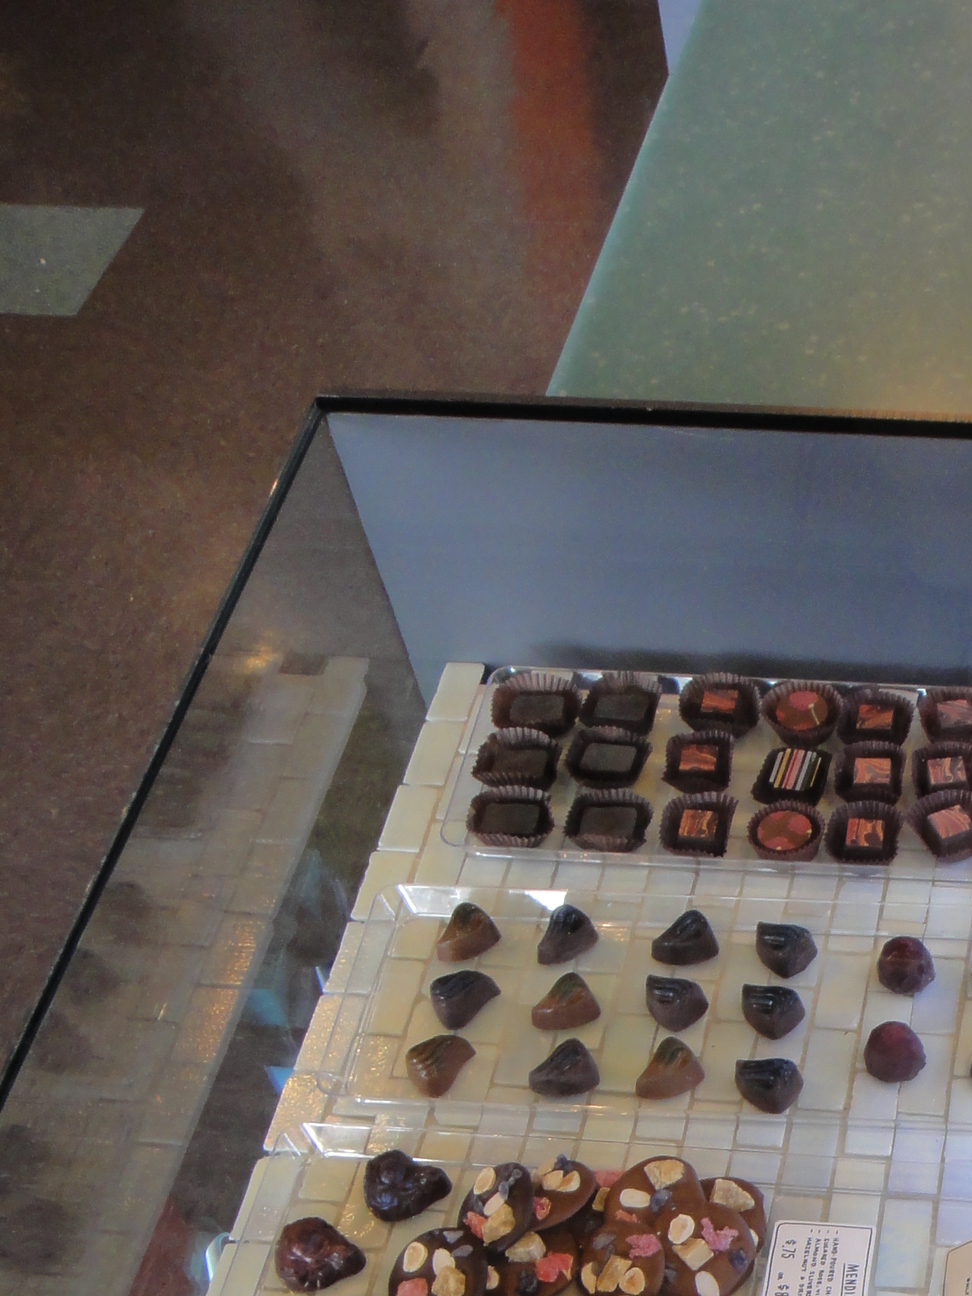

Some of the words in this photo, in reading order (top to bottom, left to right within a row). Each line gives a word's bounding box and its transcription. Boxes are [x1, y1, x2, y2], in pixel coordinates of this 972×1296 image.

[801, 1236, 811, 1272] HAZELNUT
[810, 1238, 820, 1267] ALMOND
[819, 1238, 829, 1265] SUGARED
[827, 1237, 838, 1282] HAND-POURED
[777, 1271, 783, 1280] OR
